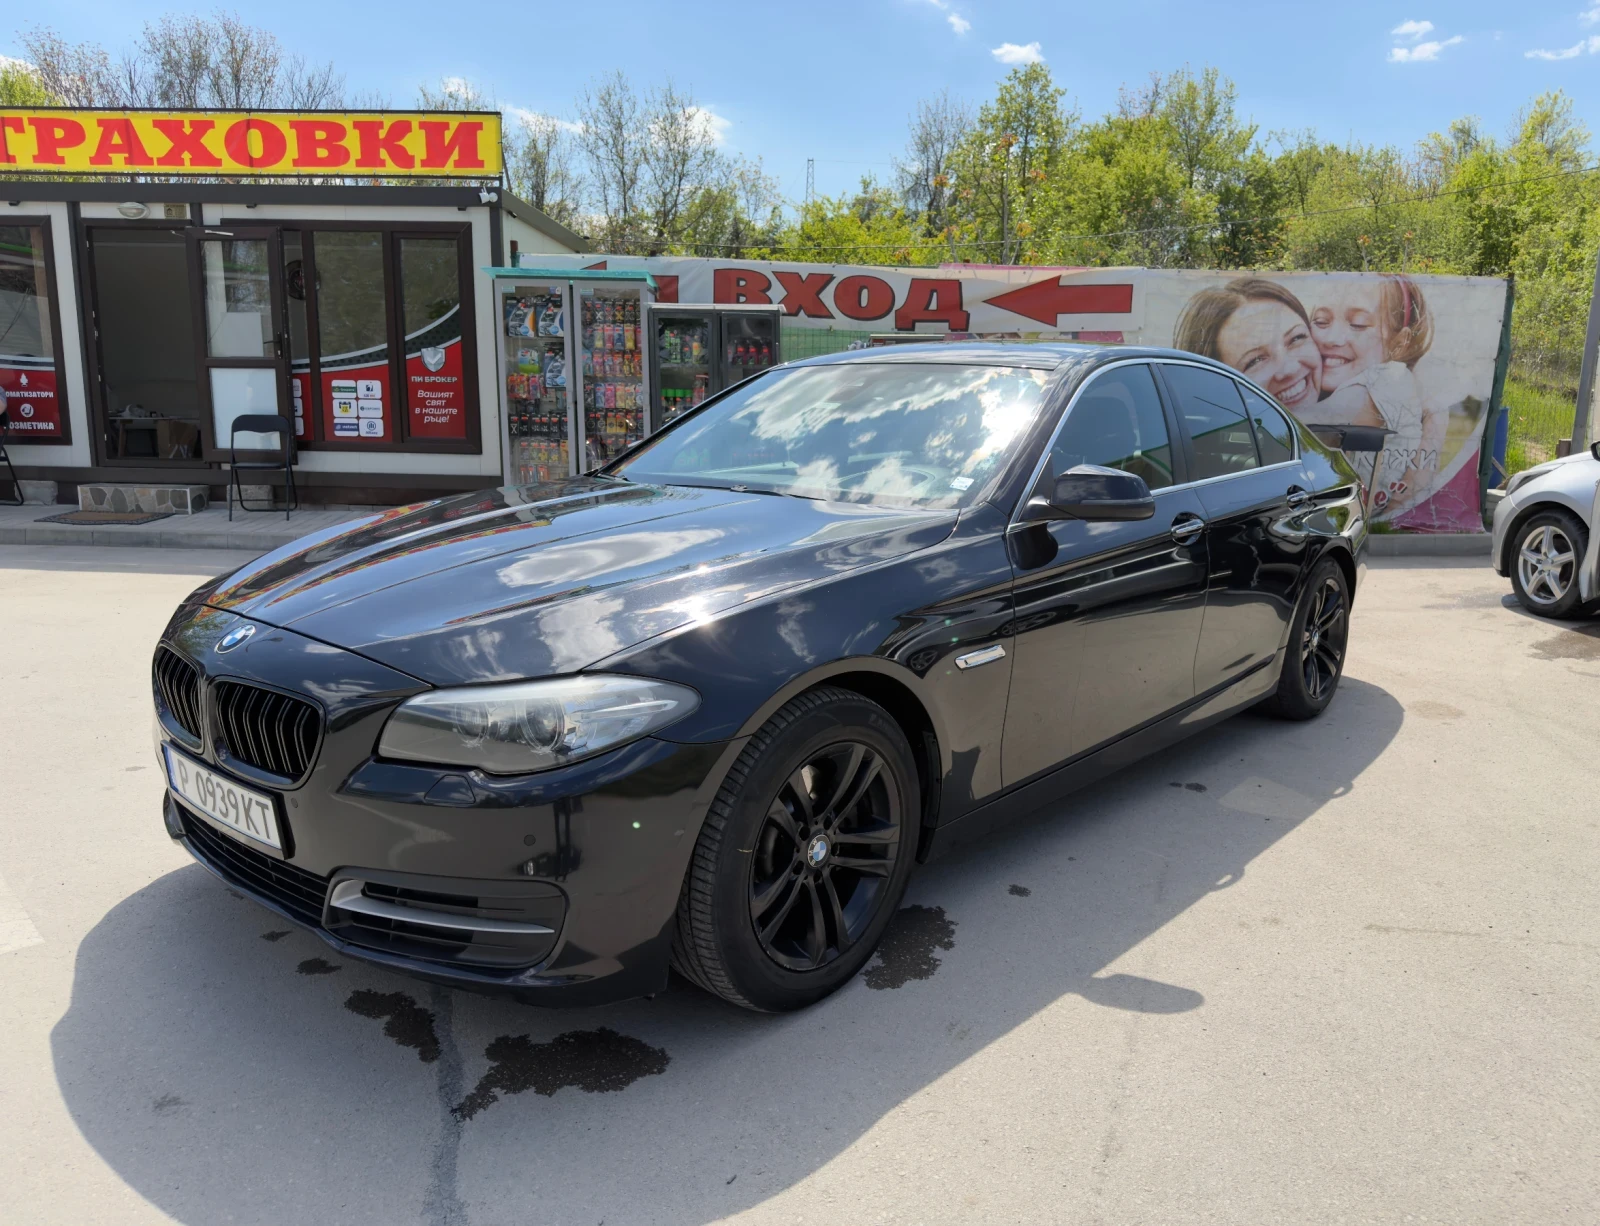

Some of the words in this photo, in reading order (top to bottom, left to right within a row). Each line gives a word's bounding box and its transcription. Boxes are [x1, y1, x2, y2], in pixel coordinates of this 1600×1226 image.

[713, 268, 971, 331] ВХОД
[417, 389, 454, 398] Вашият
[425, 399, 446, 407] свят
[422, 407, 458, 415] нашите
[424, 415, 450, 424] ръце!
[9, 421, 54, 430] ОЗМЕТИКА
